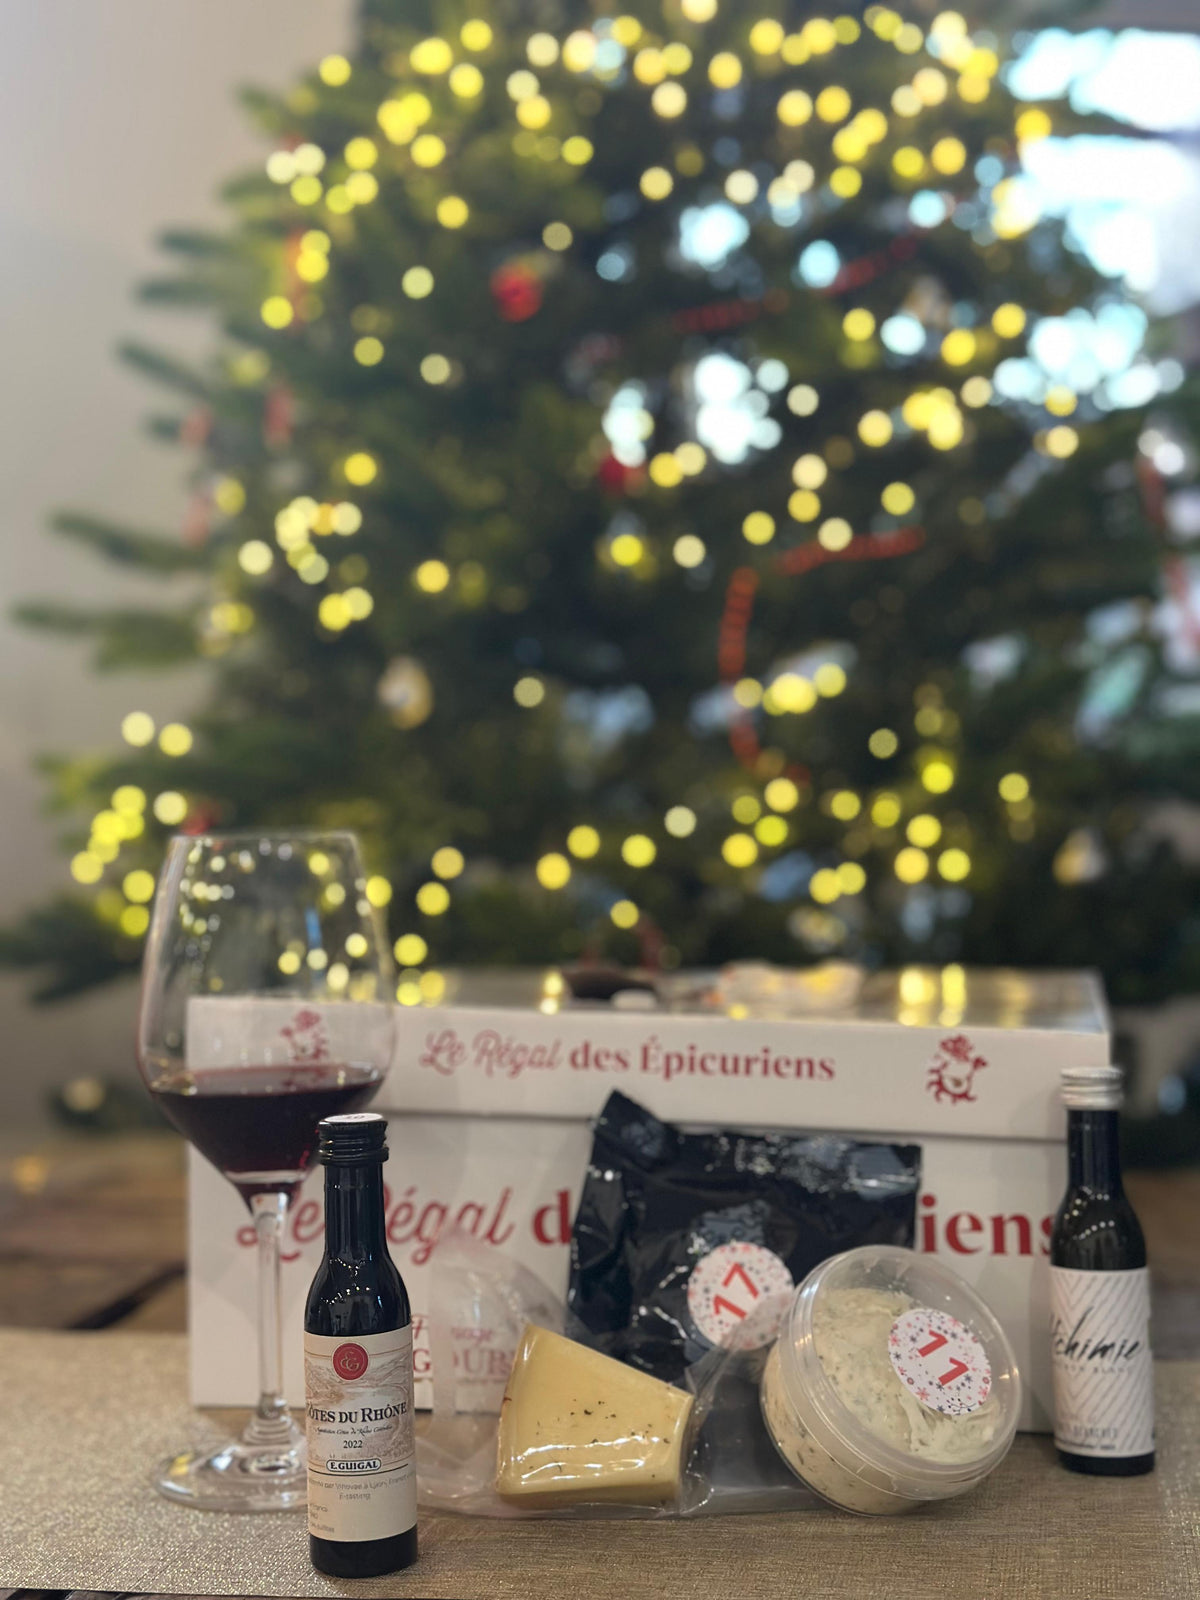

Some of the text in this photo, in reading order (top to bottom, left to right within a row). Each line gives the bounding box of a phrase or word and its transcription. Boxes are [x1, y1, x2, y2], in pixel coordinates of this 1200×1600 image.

[418, 1028, 836, 1082] Le Régal des Épicuriens
[383, 1182, 515, 1266] égal
[713, 1262, 760, 1321] 17
[338, 1411, 358, 1424] DU
[360, 1401, 407, 1423] RHÔNE
[343, 1440, 363, 1449] 2022
